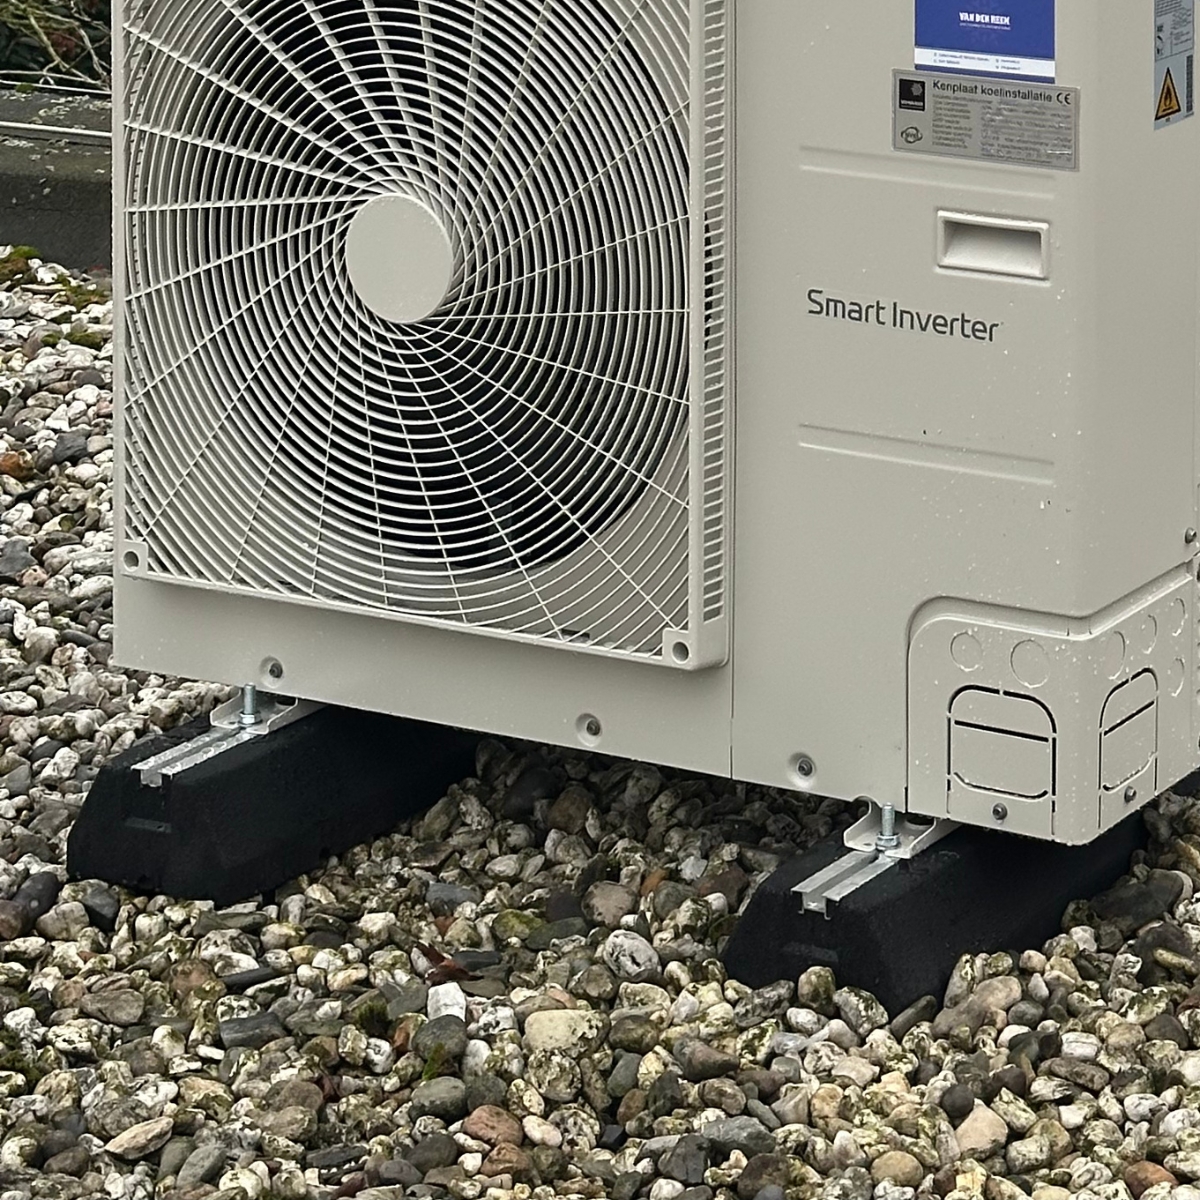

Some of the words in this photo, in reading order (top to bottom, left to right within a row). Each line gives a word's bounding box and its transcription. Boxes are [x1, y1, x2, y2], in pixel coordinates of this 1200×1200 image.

[959, 12, 975, 21] VAN
[933, 80, 978, 94] Kenplaat
[980, 84, 1053, 103] koelinstallatie
[807, 288, 886, 326] Smart
[892, 301, 1000, 342] Inverter
